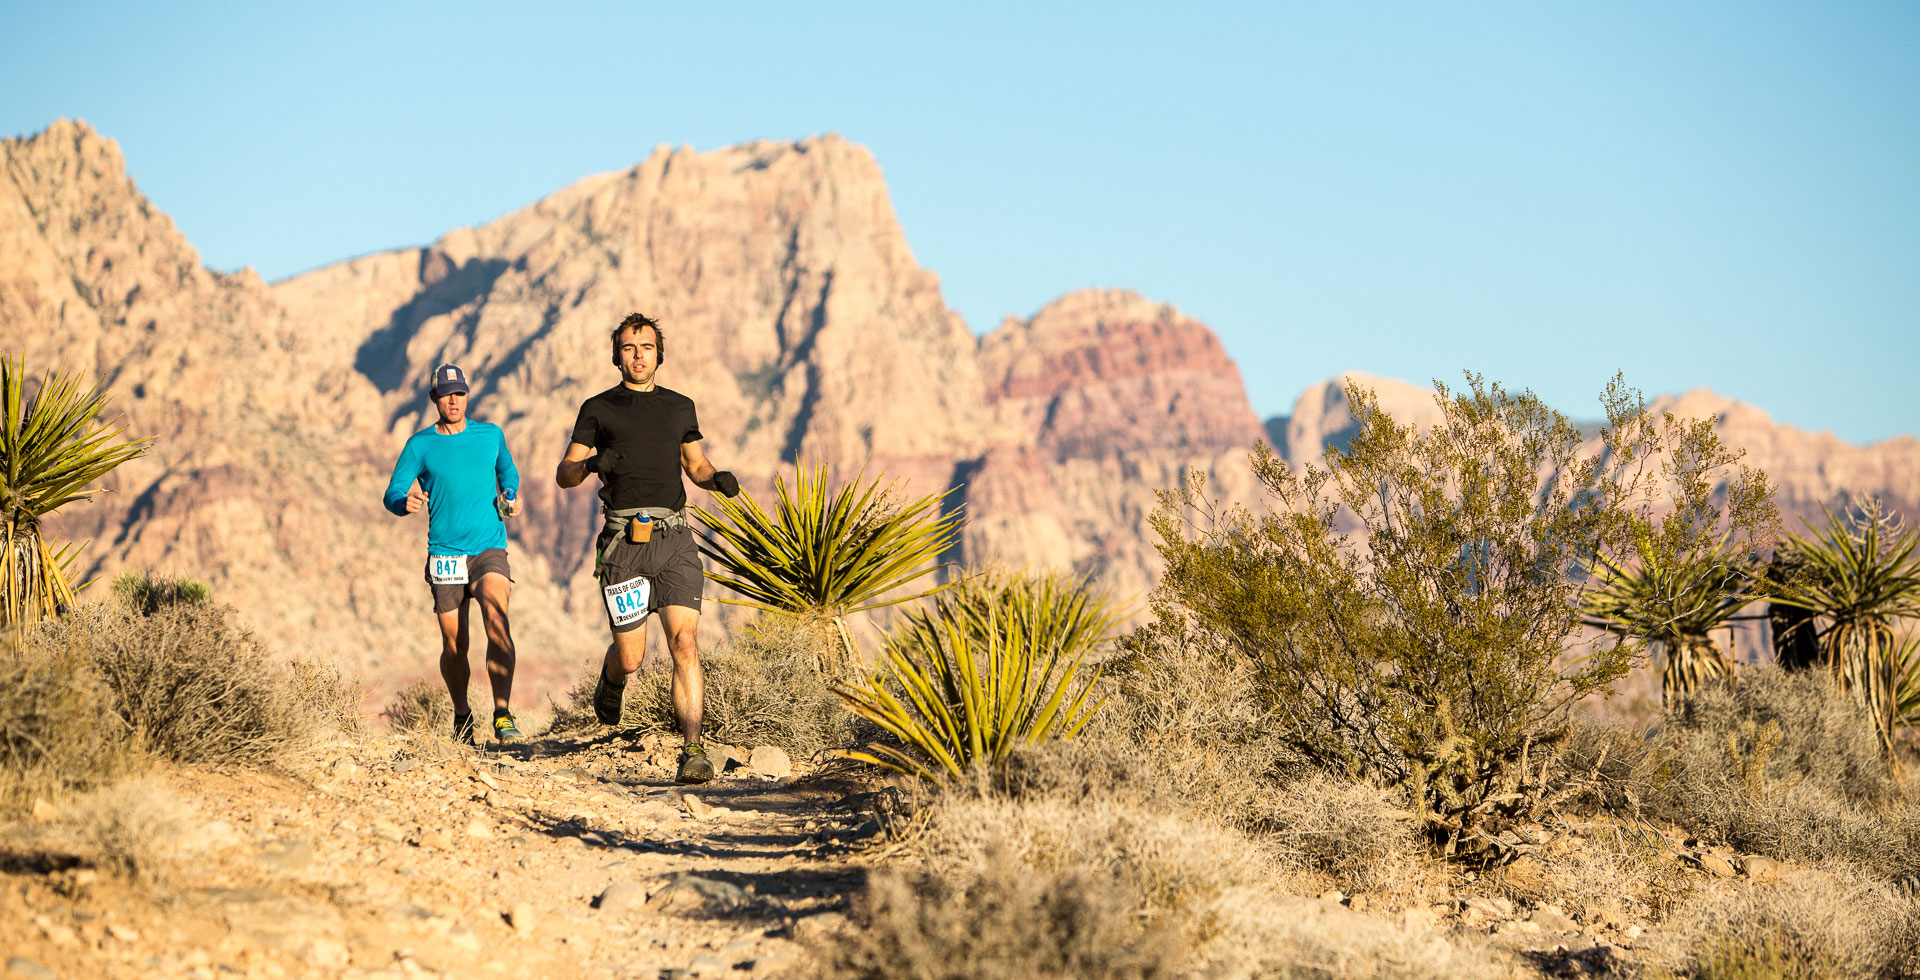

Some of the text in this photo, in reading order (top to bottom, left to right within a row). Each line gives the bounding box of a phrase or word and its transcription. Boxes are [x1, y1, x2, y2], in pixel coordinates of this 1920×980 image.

[437, 560, 457, 575] 847
[607, 579, 644, 596] TRAILS OF GLORY
[616, 590, 644, 613] 842
